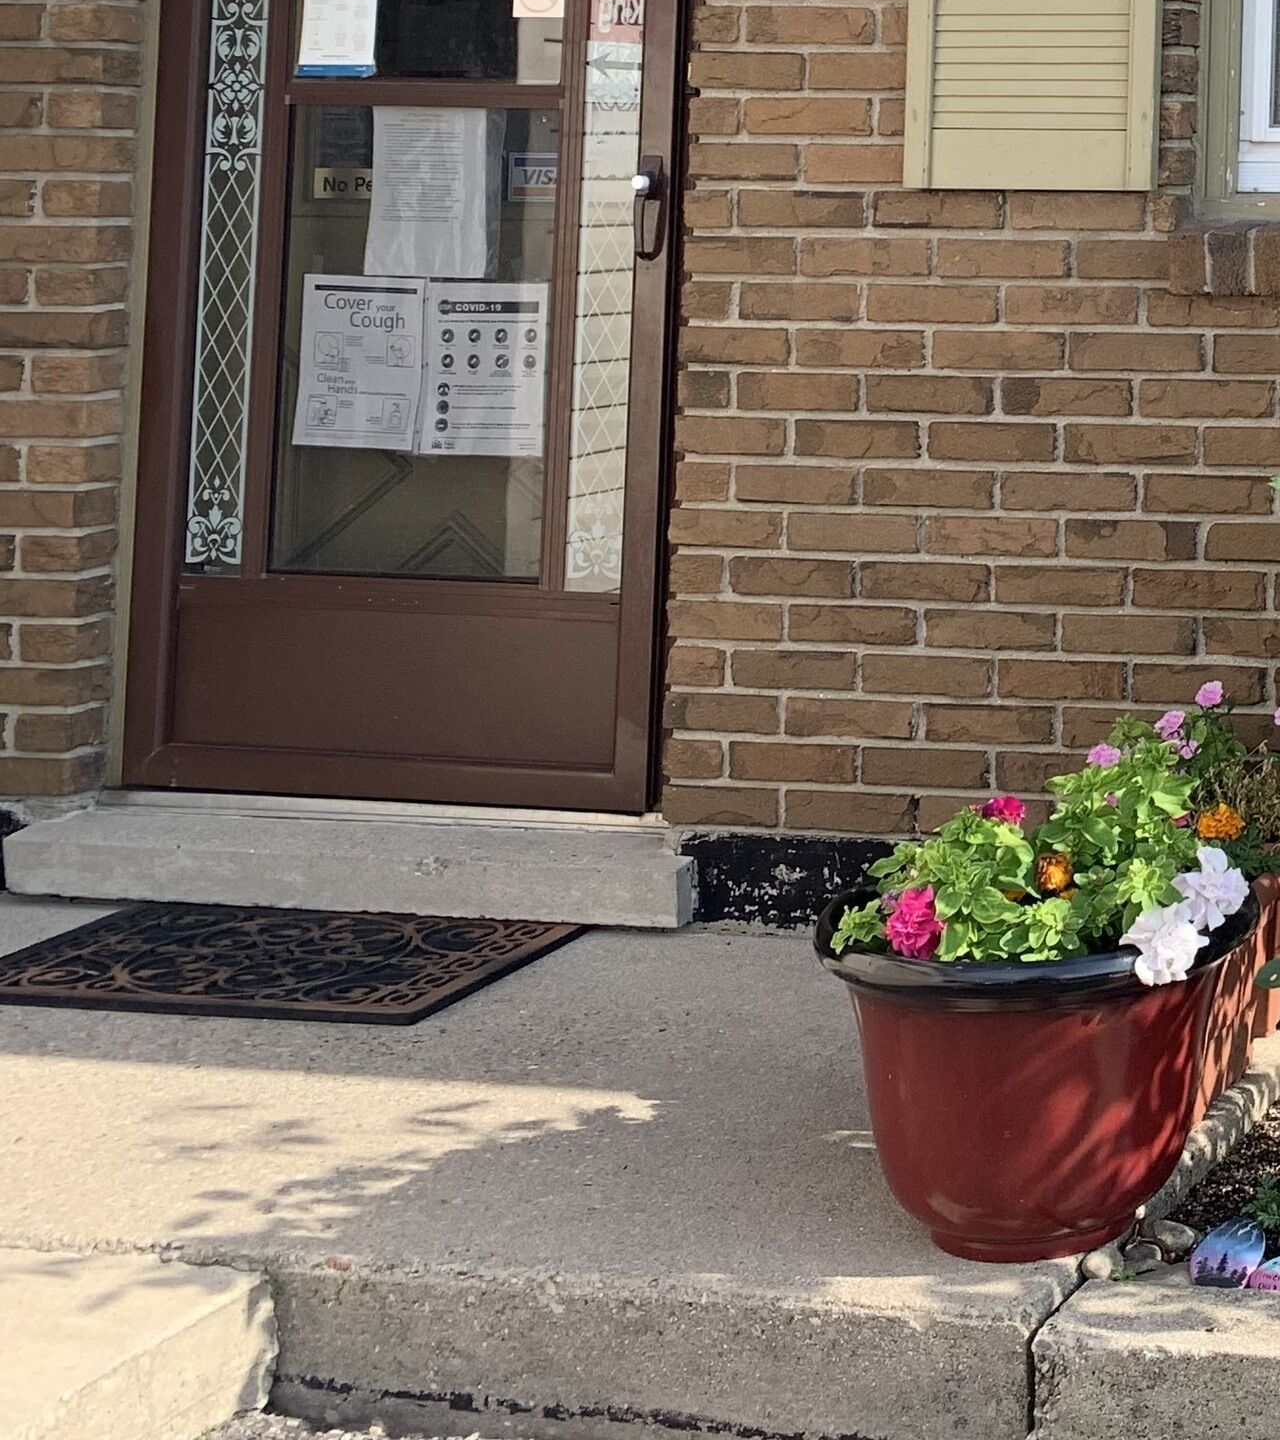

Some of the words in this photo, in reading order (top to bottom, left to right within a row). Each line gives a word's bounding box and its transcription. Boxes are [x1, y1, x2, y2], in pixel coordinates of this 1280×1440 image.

[323, 176, 348, 193] No
[354, 176, 373, 193] Pe
[324, 293, 373, 310] Cover
[375, 304, 396, 313] your
[455, 303, 502, 312] COVID-19
[349, 311, 405, 333] Cough
[317, 372, 344, 384] Clean
[327, 384, 358, 394] Hands
